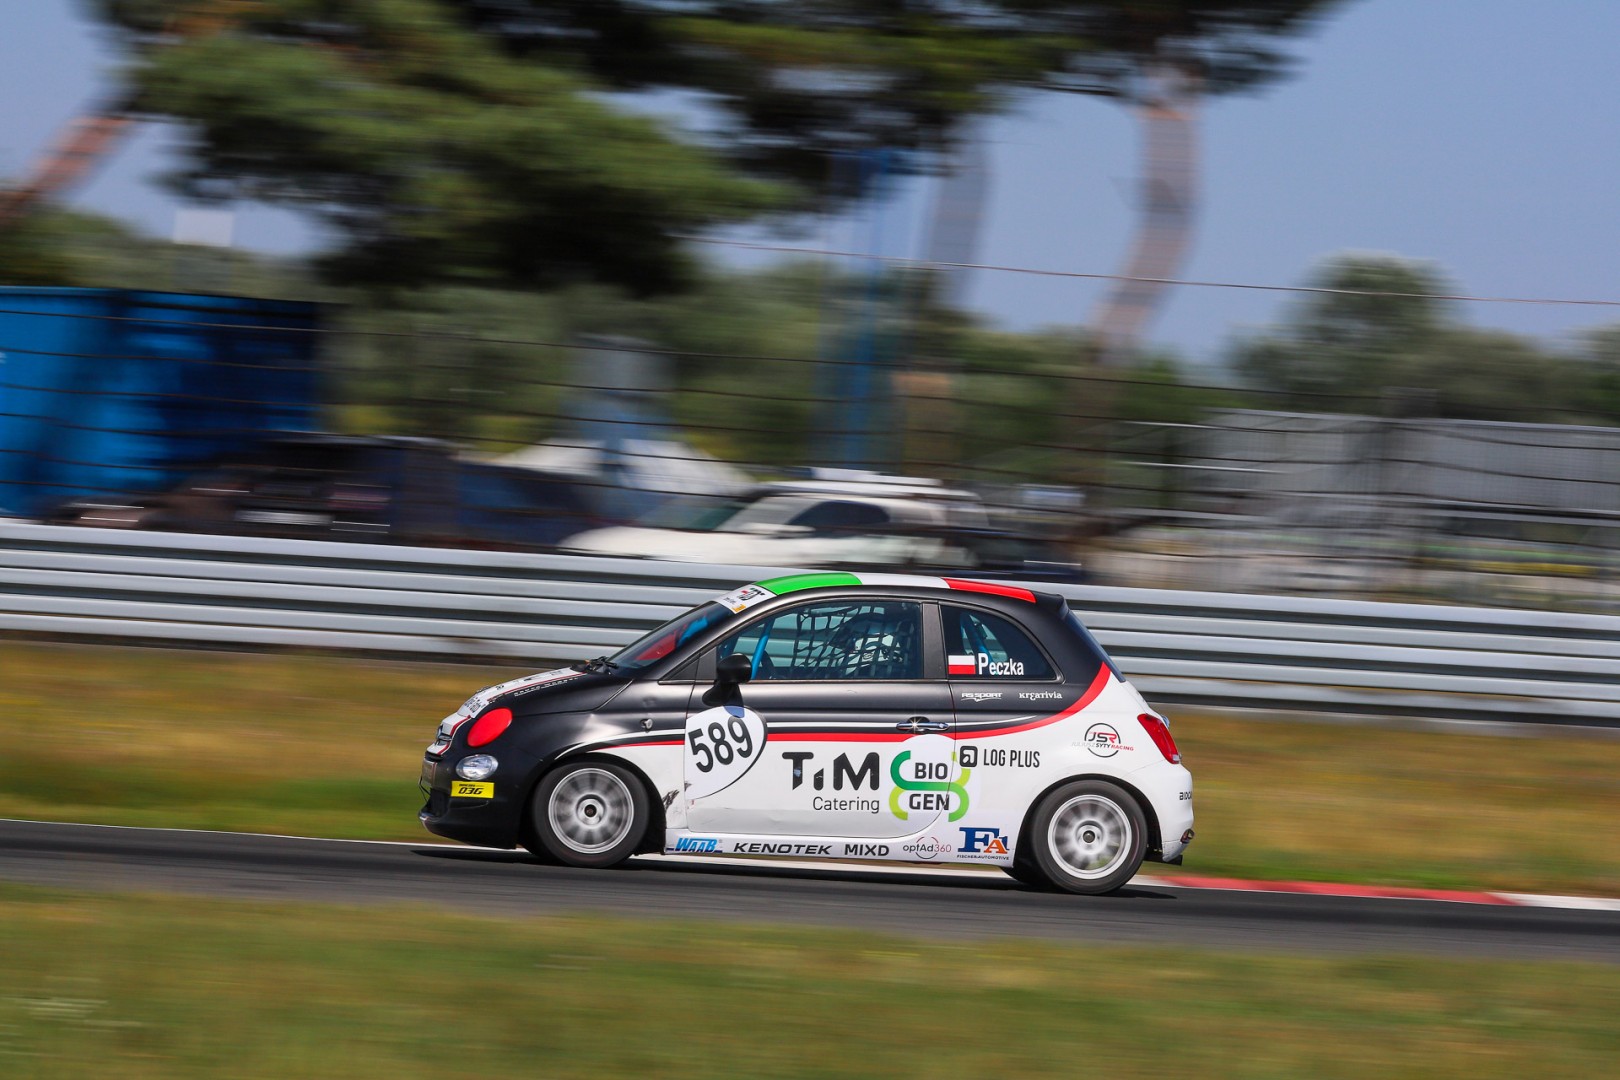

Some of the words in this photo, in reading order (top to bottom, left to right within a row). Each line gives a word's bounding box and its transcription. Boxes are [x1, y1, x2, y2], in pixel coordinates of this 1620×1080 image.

[978, 652, 1024, 676] Peczka
[688, 716, 753, 773] 589
[983, 749, 1006, 767] LOG
[1009, 749, 1040, 768] PLUS
[914, 762, 948, 780] BIO
[813, 796, 880, 814] Catering
[909, 793, 950, 811] GEN
[733, 842, 833, 856] KENOTEK
[844, 844, 890, 856] MIXD
